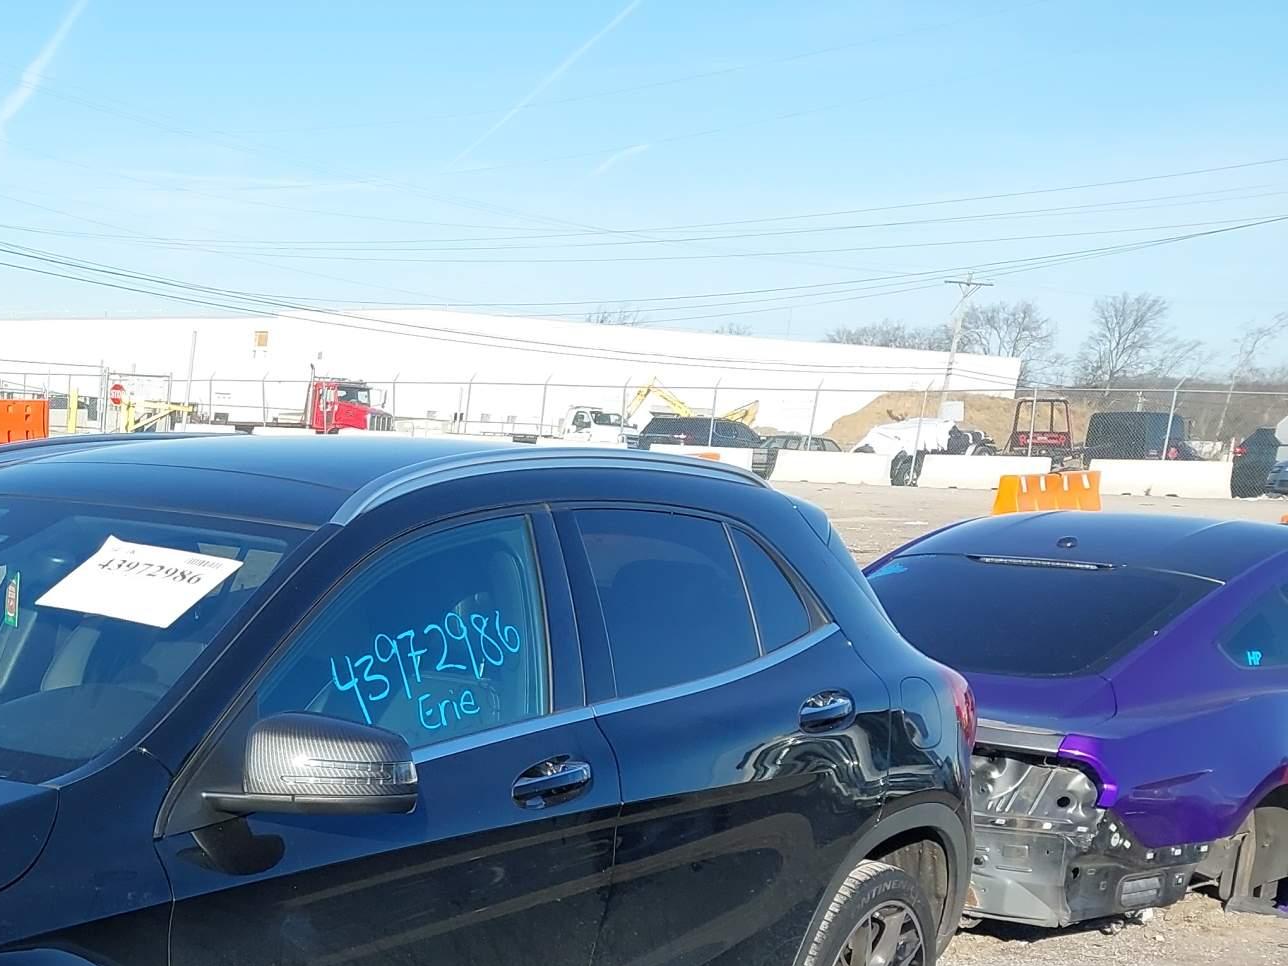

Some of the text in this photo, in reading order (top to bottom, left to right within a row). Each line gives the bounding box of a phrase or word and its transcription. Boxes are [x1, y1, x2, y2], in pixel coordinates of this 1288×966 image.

[98, 557, 203, 585] 43972986
[331, 611, 520, 724] 43972986
[418, 690, 480, 729] Erie
